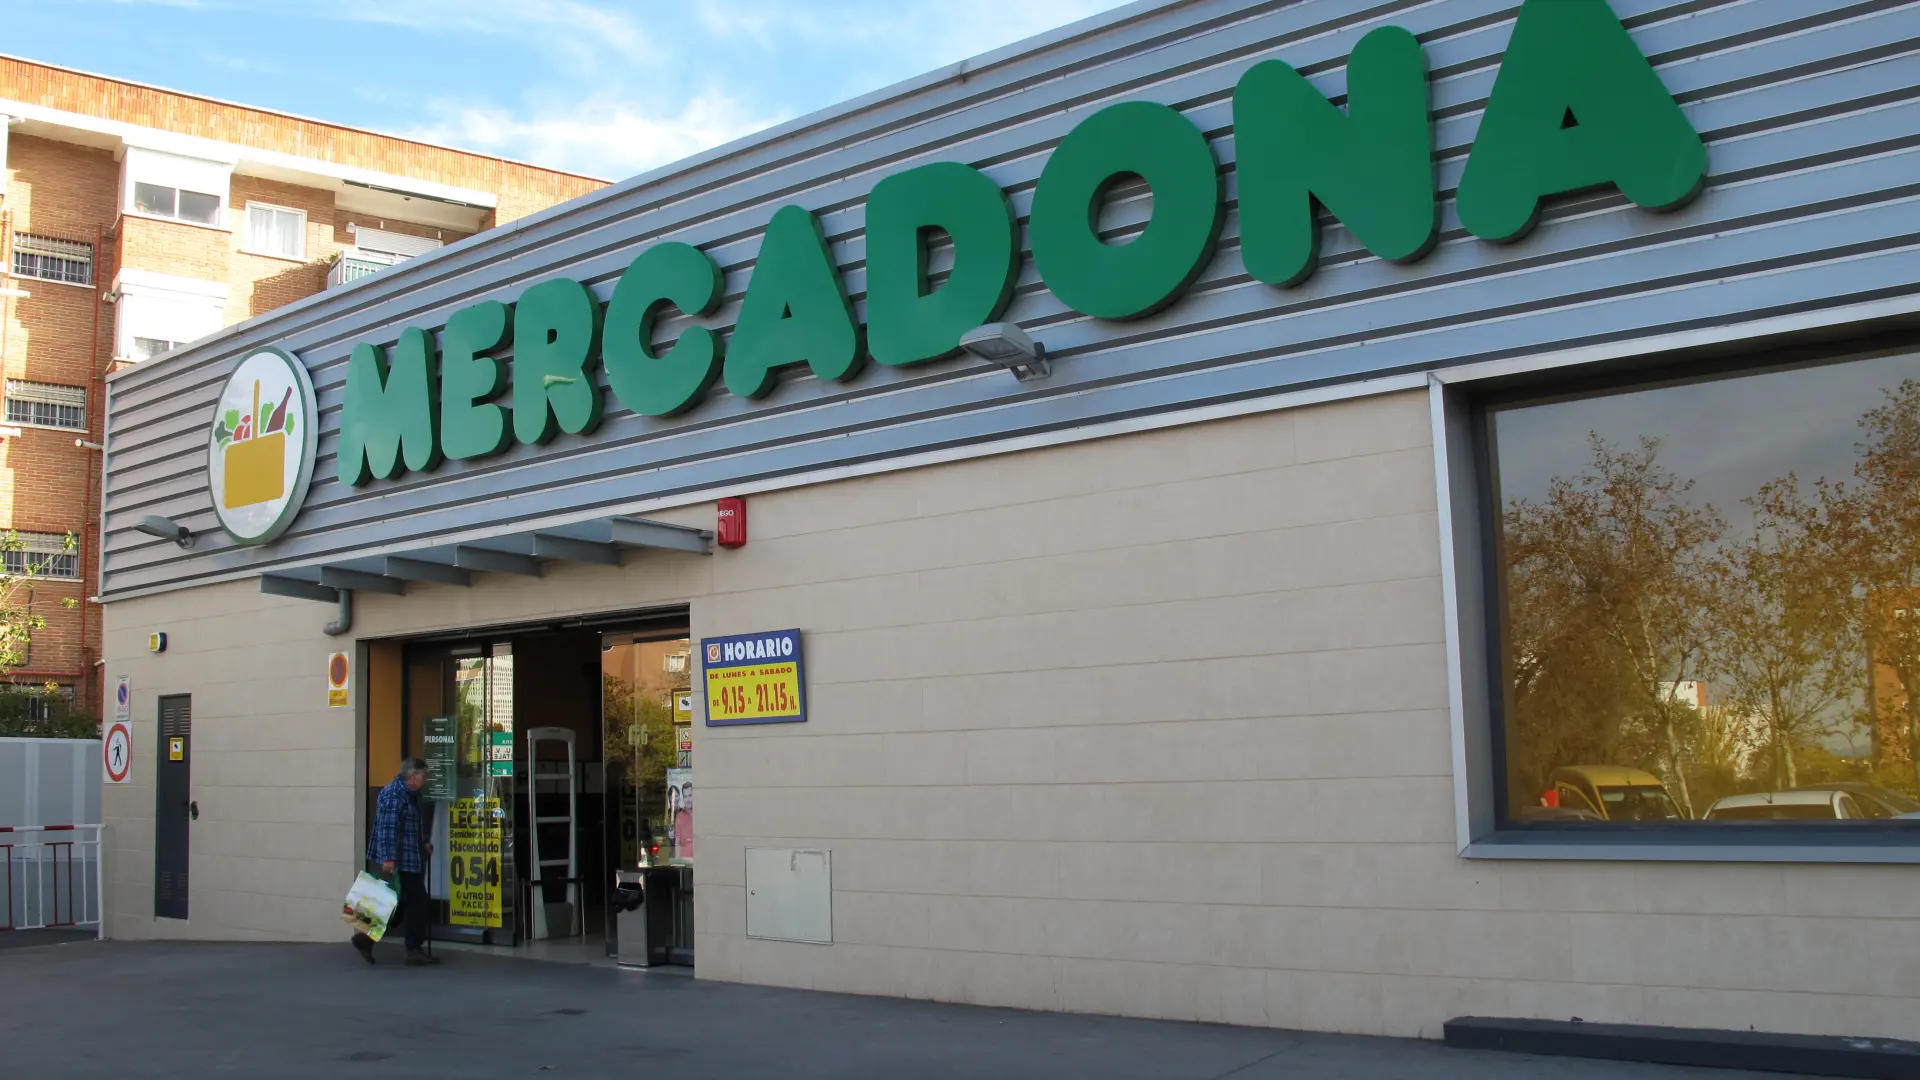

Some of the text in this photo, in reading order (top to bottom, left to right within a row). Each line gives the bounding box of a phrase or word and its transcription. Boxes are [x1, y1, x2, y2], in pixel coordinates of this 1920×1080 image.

[336, 0, 1707, 488] MERCADONA
[724, 636, 793, 661] HORARIO
[709, 672, 719, 680] DE
[722, 670, 747, 679] LUNES
[759, 666, 793, 676] SABADO
[712, 699, 720, 707] DE
[721, 686, 746, 714] 9.15
[747, 697, 752, 705] A
[755, 682, 788, 713] 21.15
[424, 735, 455, 744] PERSONAL
[449, 810, 499, 829] LECHE
[449, 840, 499, 853] Hacendado
[451, 855, 500, 890] 0,54
